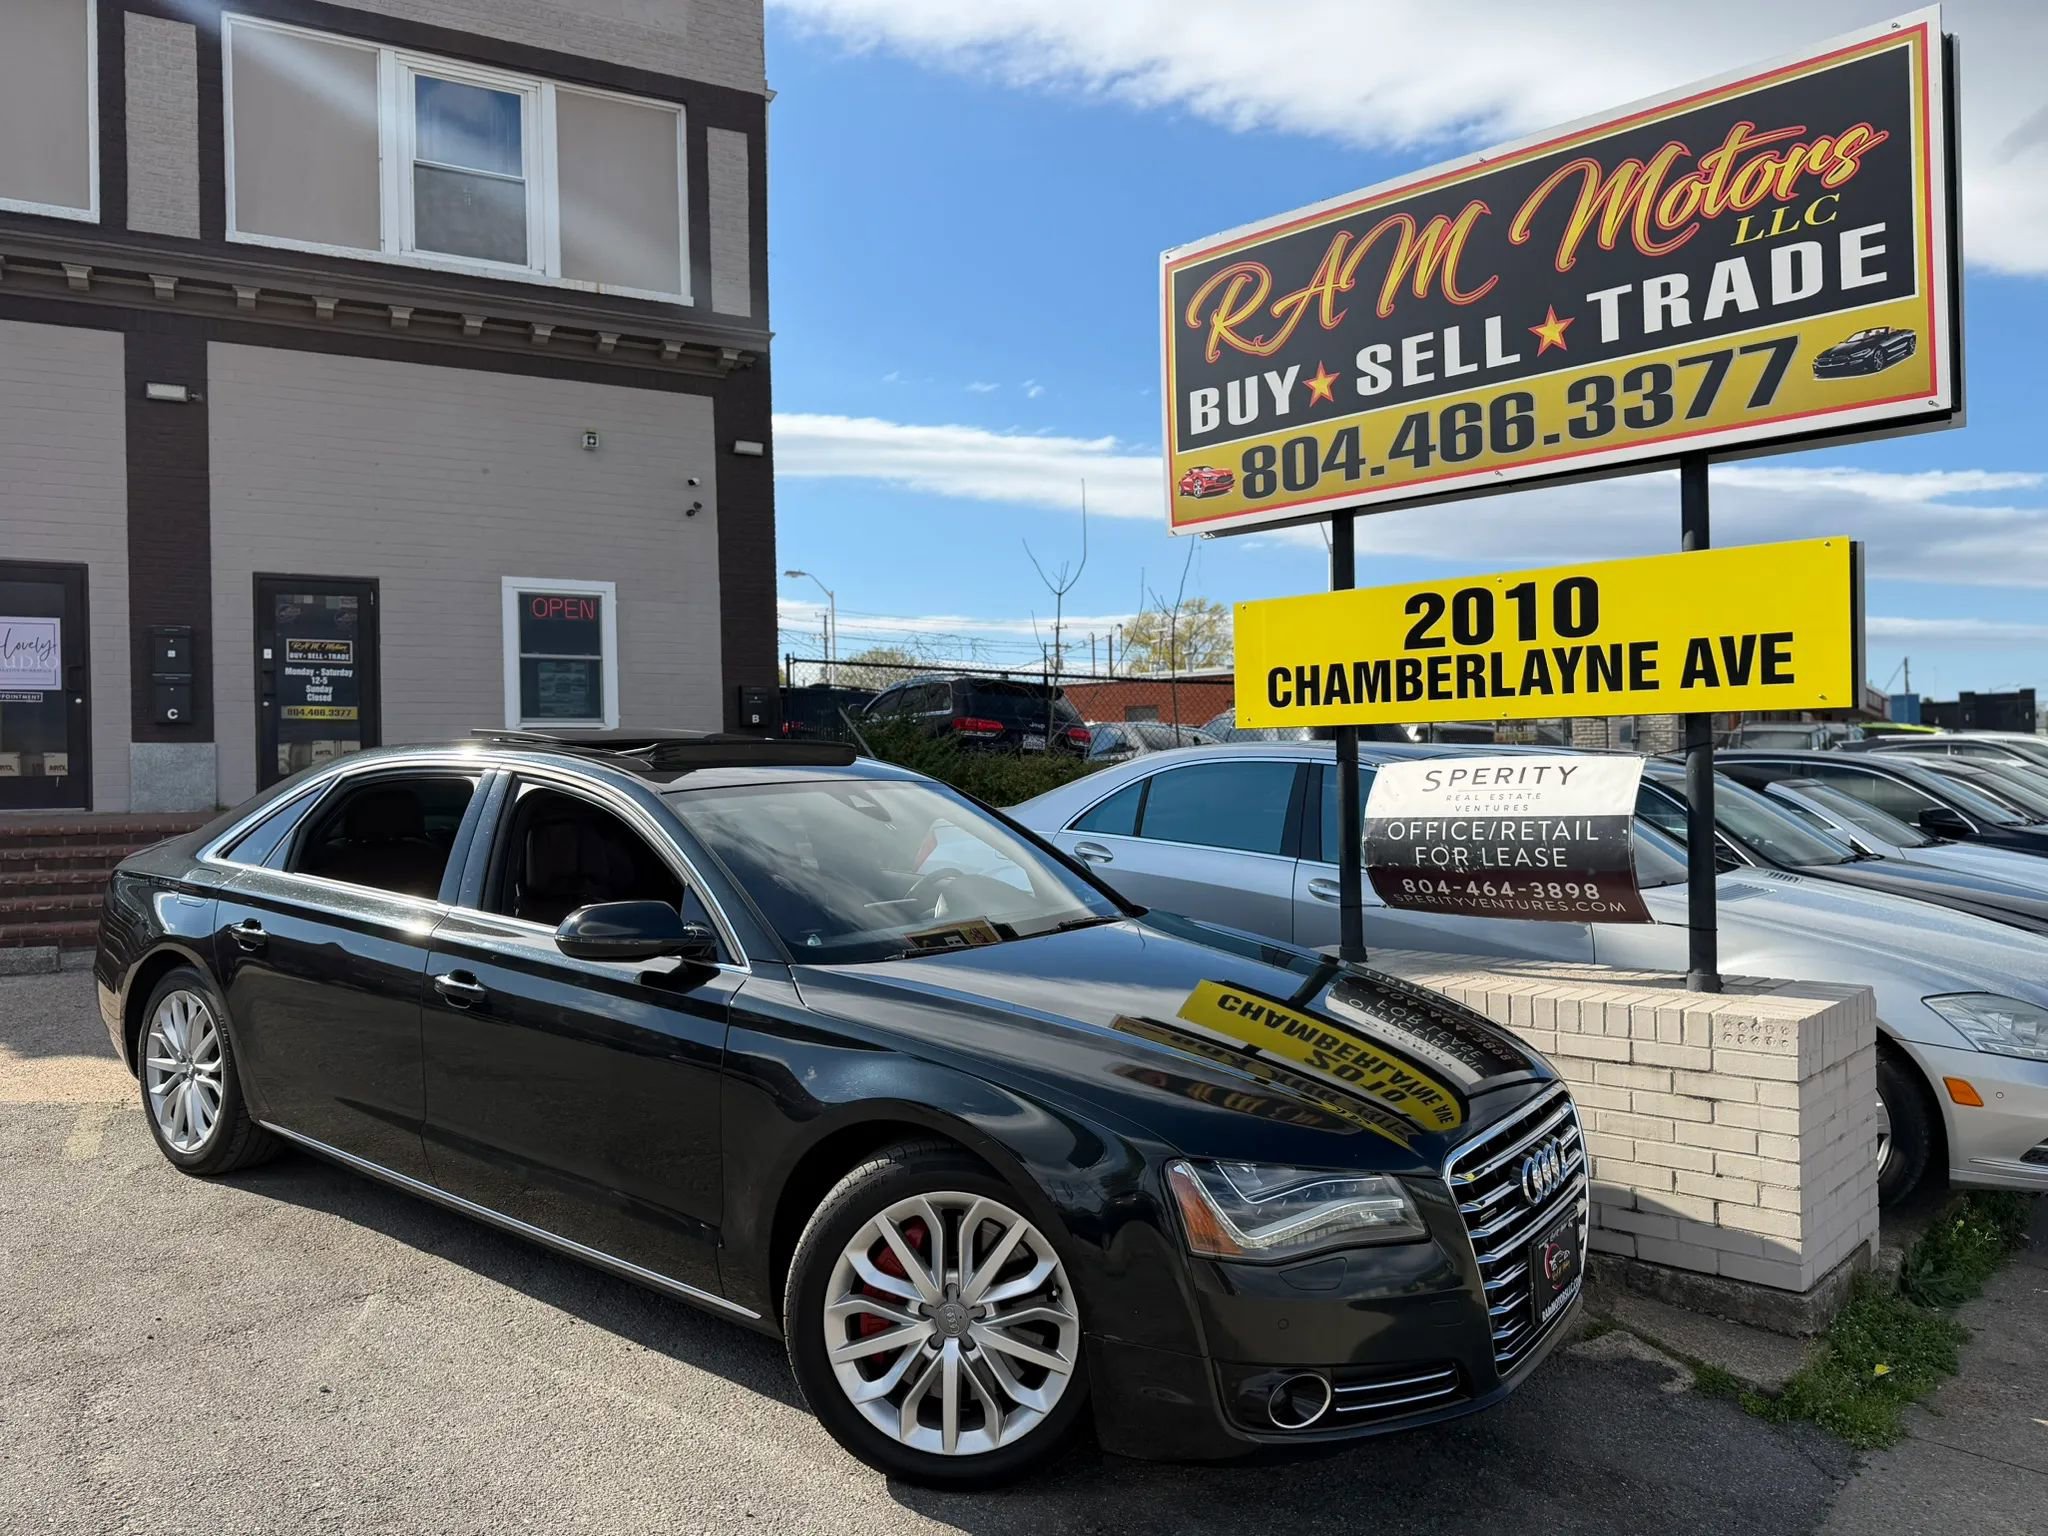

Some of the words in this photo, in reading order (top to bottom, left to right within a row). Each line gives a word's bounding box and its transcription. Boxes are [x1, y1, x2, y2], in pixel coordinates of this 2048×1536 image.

[1731, 193, 1841, 246] LLC
[1185, 200, 1498, 363] RAM
[1508, 121, 1889, 272] Motors
[1190, 364, 1300, 436] BUY
[1356, 315, 1521, 397] SELL
[1586, 222, 1888, 344] TRADE
[1240, 334, 1801, 500] 804.466.3377
[532, 597, 595, 620] OPEN
[1403, 576, 1600, 651] 2010
[289, 652, 304, 660] BUY
[328, 653, 350, 661] TRADE
[285, 667, 314, 676] Monday
[320, 668, 353, 677] Saturday
[311, 676, 328, 685] 12-5
[1267, 641, 1660, 709] CHAMBERLAYNE
[1680, 632, 1795, 689] AVE
[305, 685, 333, 694] Sunday
[307, 693, 333, 702] Closed
[167, 708, 179, 720] C
[752, 714, 760, 724] B
[1422, 765, 1579, 792] SPERITY
[1446, 794, 1479, 802] REAL
[1489, 793, 1542, 801] ESTATE
[1455, 804, 1530, 812] VENTURES
[1387, 820, 1600, 841] OFFICE/RETAIL
[1415, 847, 1470, 867] FOR
[1481, 847, 1568, 868] LEASE
[1401, 878, 1600, 900] 804-464-3898
[1393, 893, 1627, 913] SPERITYVENTURES.COM
